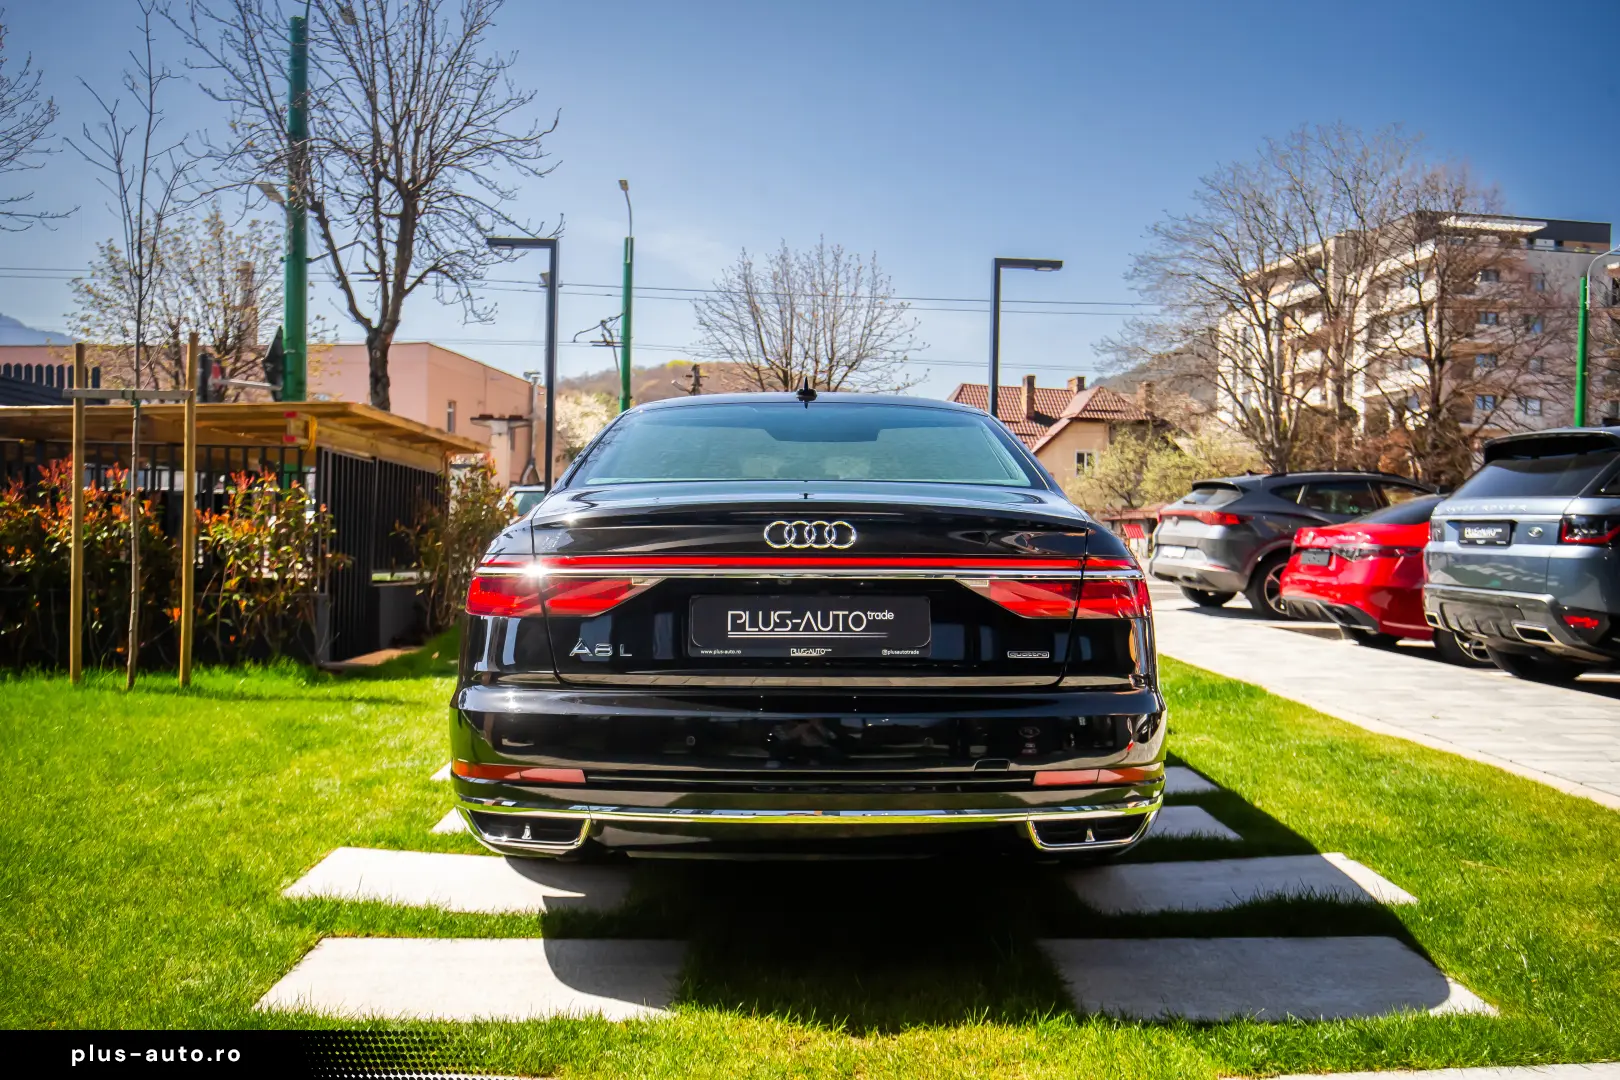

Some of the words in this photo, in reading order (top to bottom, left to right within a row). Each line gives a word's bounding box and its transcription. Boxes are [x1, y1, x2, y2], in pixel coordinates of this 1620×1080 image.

[728, 610, 867, 631] PLUS-AUTO
[867, 609, 895, 620] trade
[620, 643, 632, 656] L
